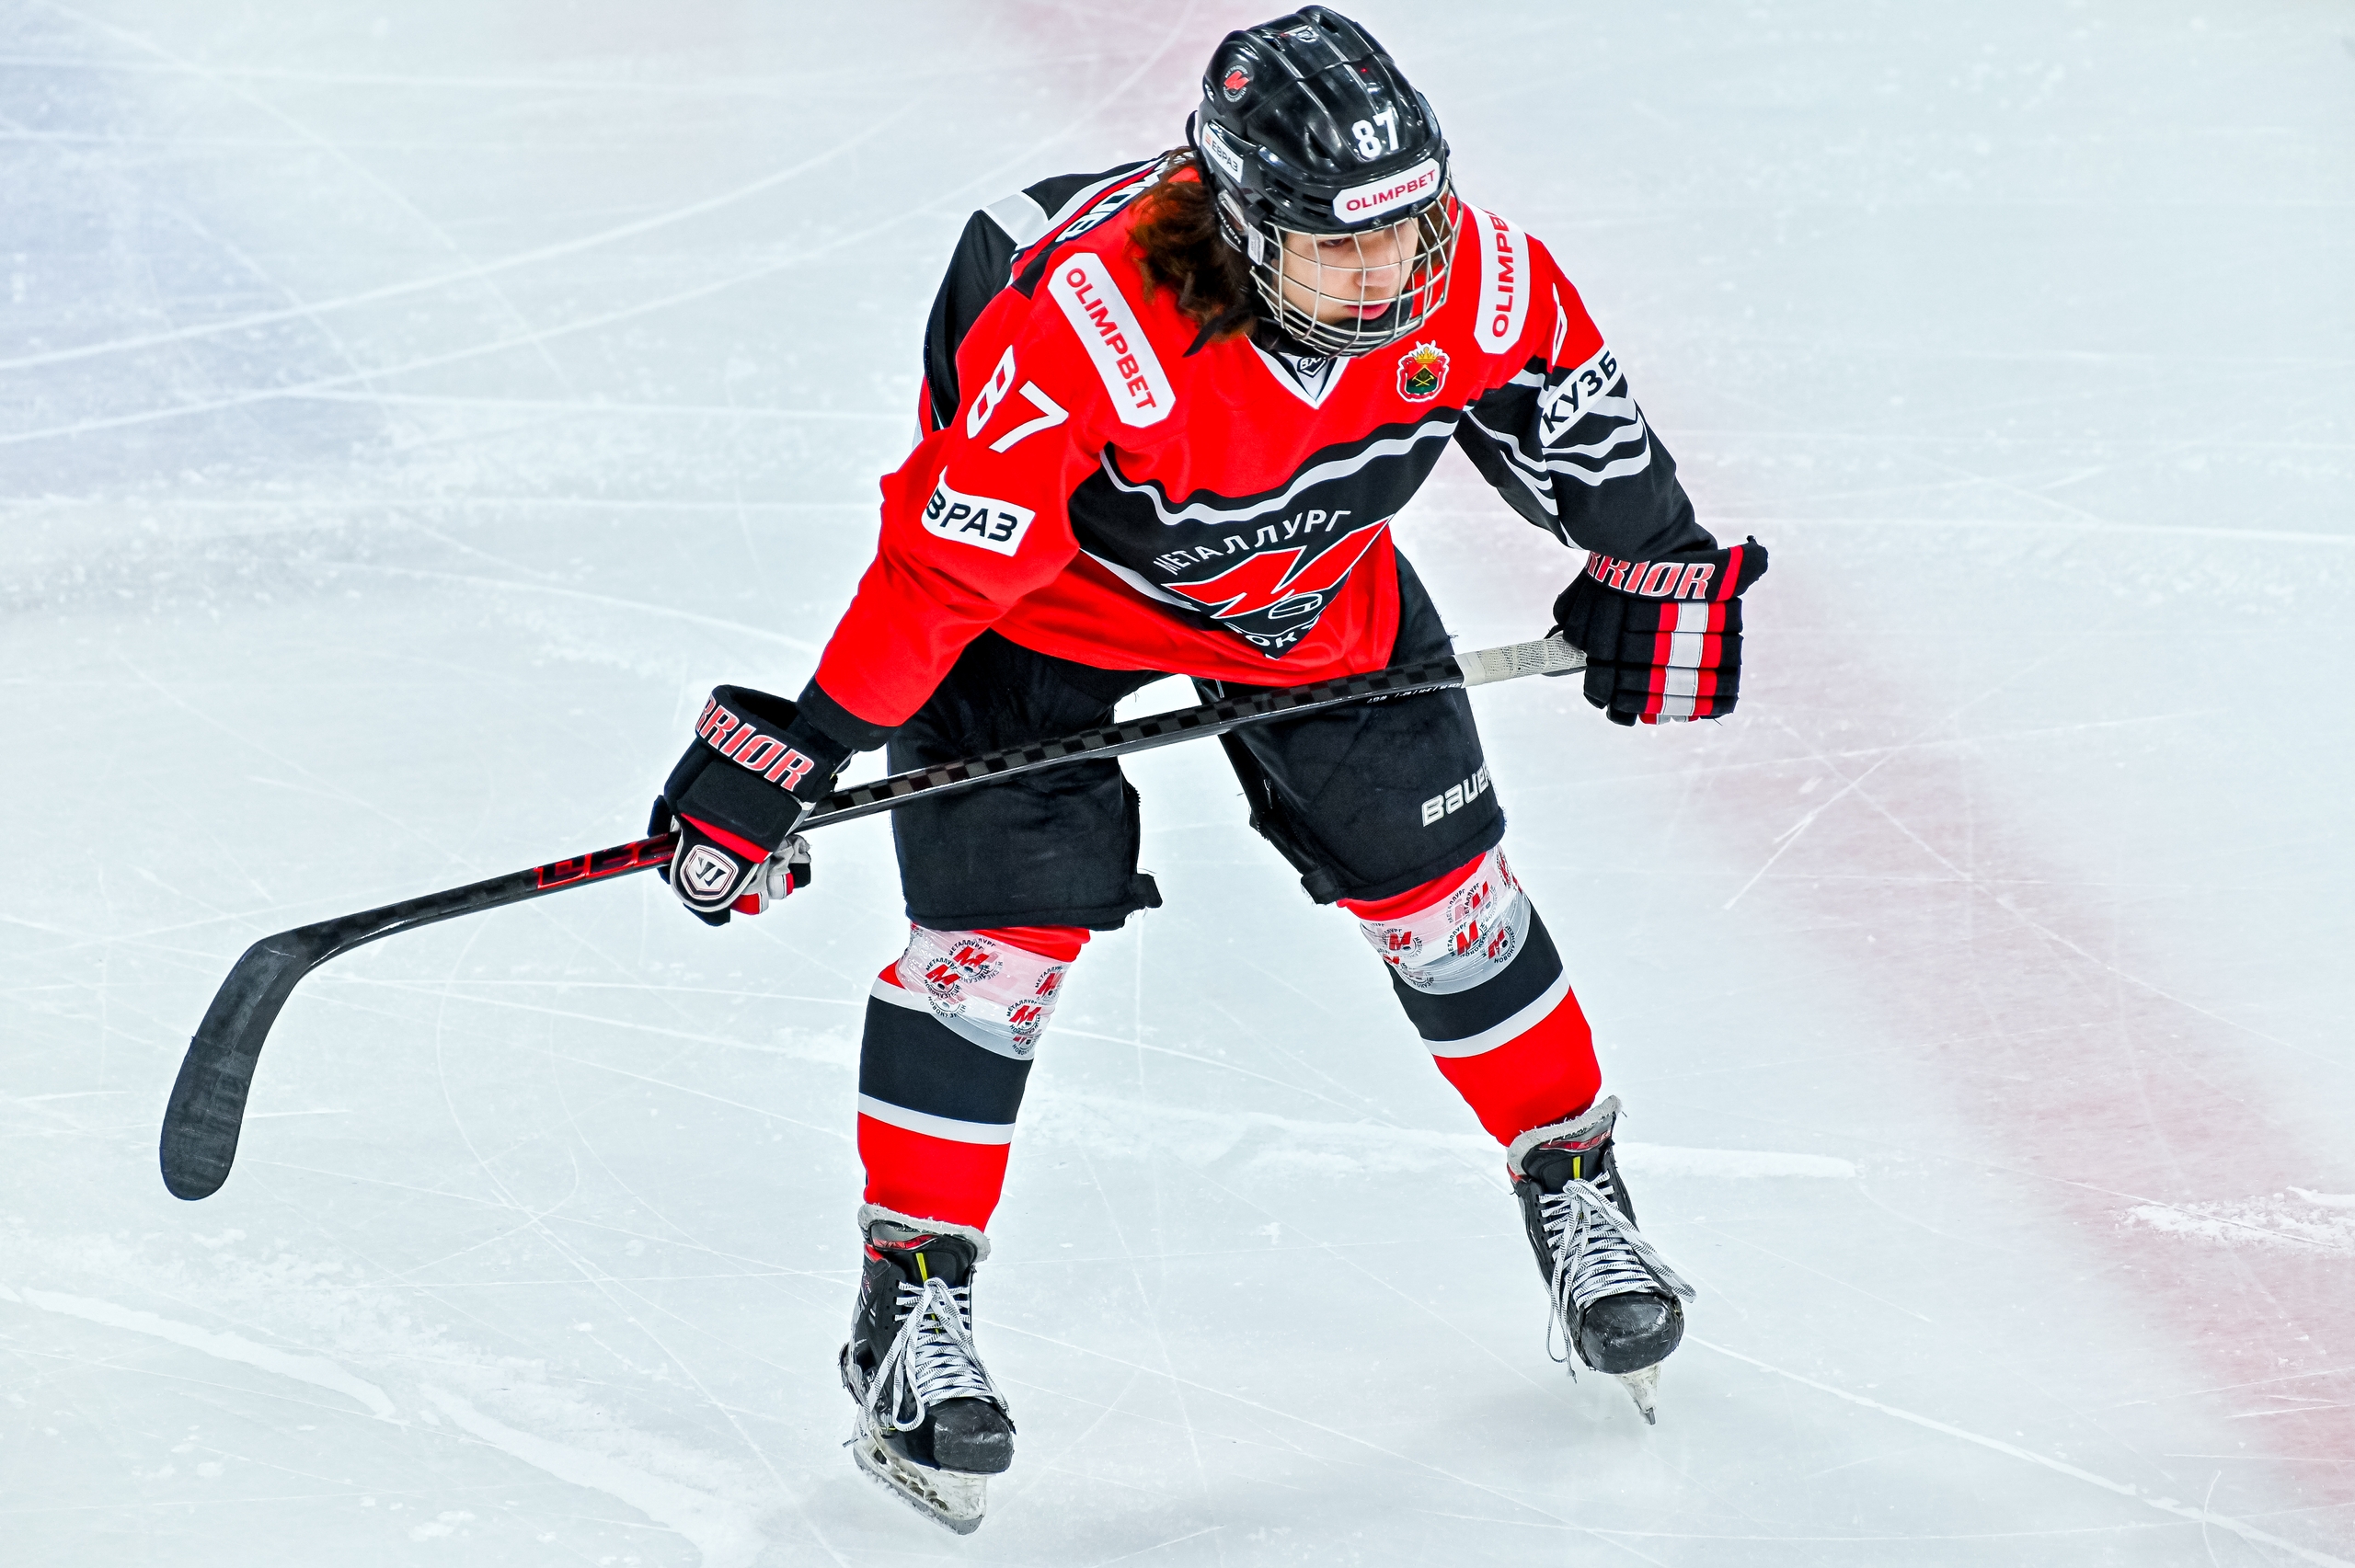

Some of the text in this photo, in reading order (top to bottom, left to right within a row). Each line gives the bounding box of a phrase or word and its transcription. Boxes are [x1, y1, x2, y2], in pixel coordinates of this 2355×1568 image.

[1212, 141, 1238, 172] ЕВРАЗ
[1351, 108, 1399, 158] 87
[1346, 169, 1435, 211] OLIMPBET
[1484, 210, 1514, 338] OLIMPB
[1065, 268, 1157, 409] OLIMPBET
[966, 344, 1069, 453] 87
[1542, 350, 1617, 434] КУЗБ
[1153, 509, 1351, 576] МЕТАЛЛУРГ
[1464, 883, 1480, 914] ЕТАЛЛУРГ
